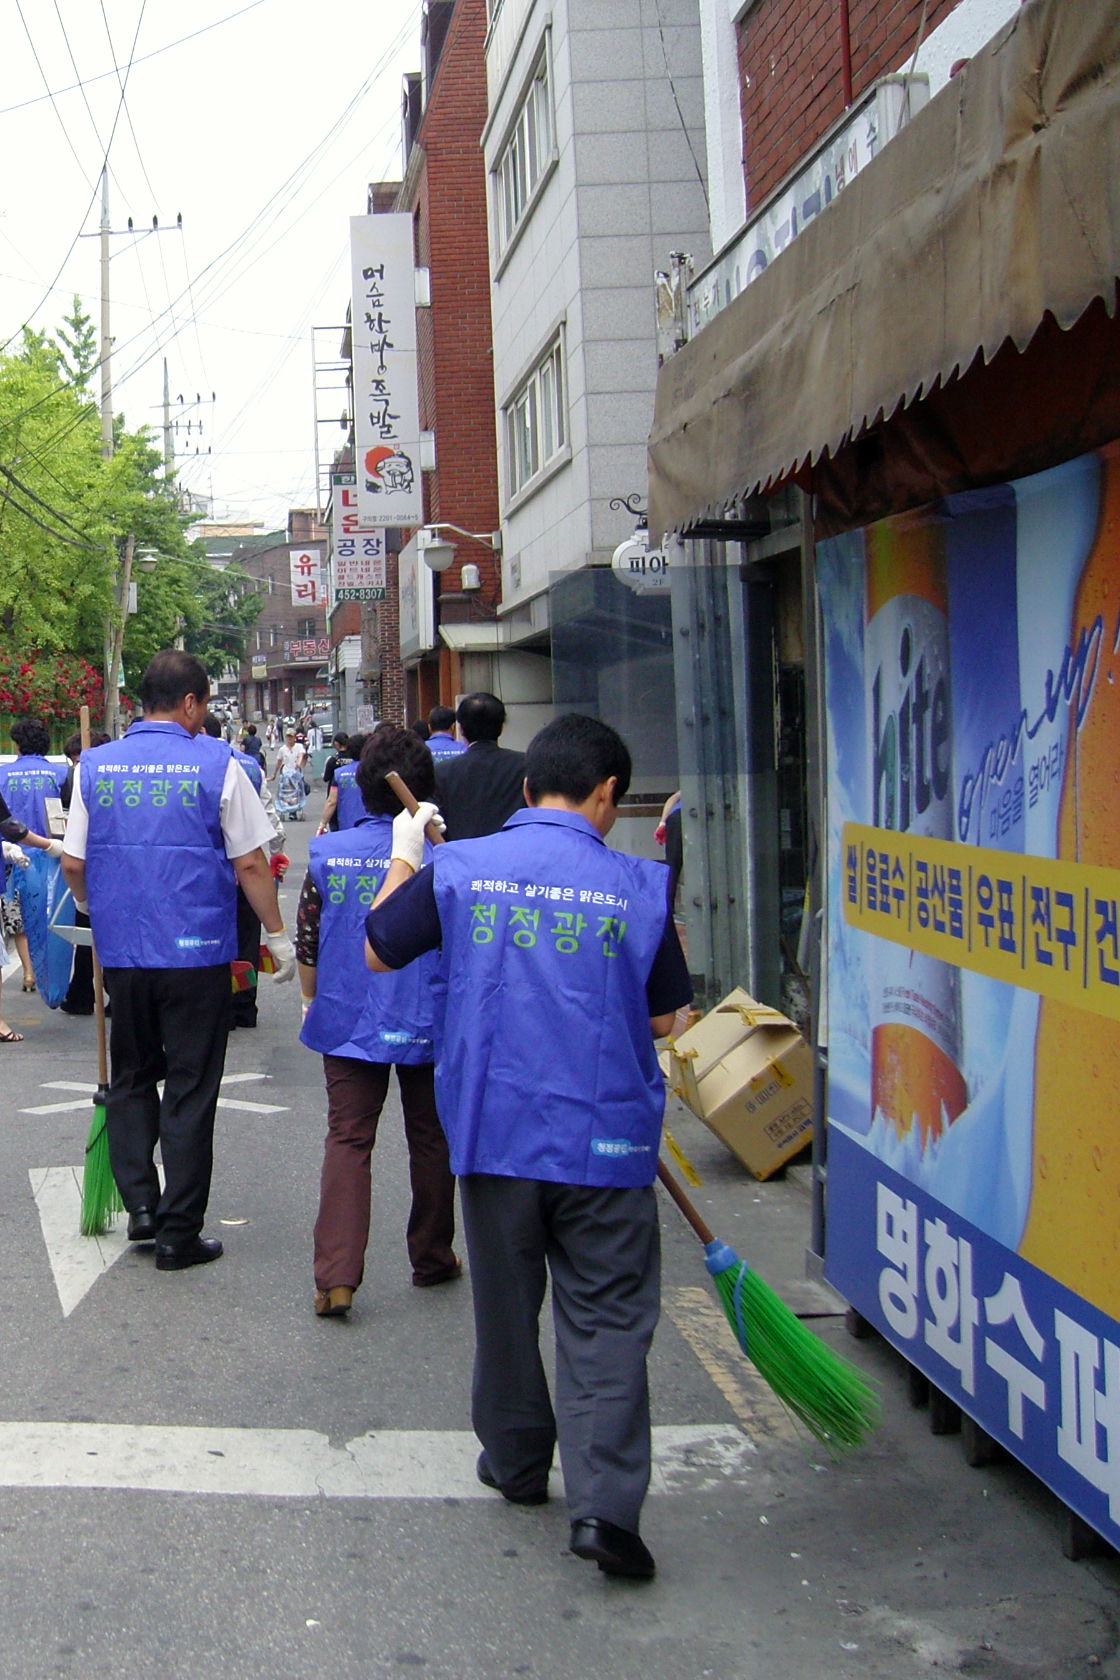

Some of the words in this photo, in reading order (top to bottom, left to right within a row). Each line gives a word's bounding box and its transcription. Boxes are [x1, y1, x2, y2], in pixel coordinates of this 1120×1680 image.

[337, 539, 382, 556] 공장
[294, 554, 317, 603] 유리
[95, 779, 200, 807] 청정광진
[990, 777, 1025, 841] 마음을
[1029, 741, 1064, 808] 열어라
[471, 879, 520, 895] 쾌적하고
[525, 883, 575, 902] 살기좋은
[579, 889, 628, 911] 맑은도시
[847, 844, 858, 905] 쌀
[865, 841, 906, 920] 음료수
[915, 859, 964, 940] 공산품
[976, 873, 1018, 955] 우표
[1030, 884, 1078, 972] 전구
[470, 902, 628, 958] 청정광진
